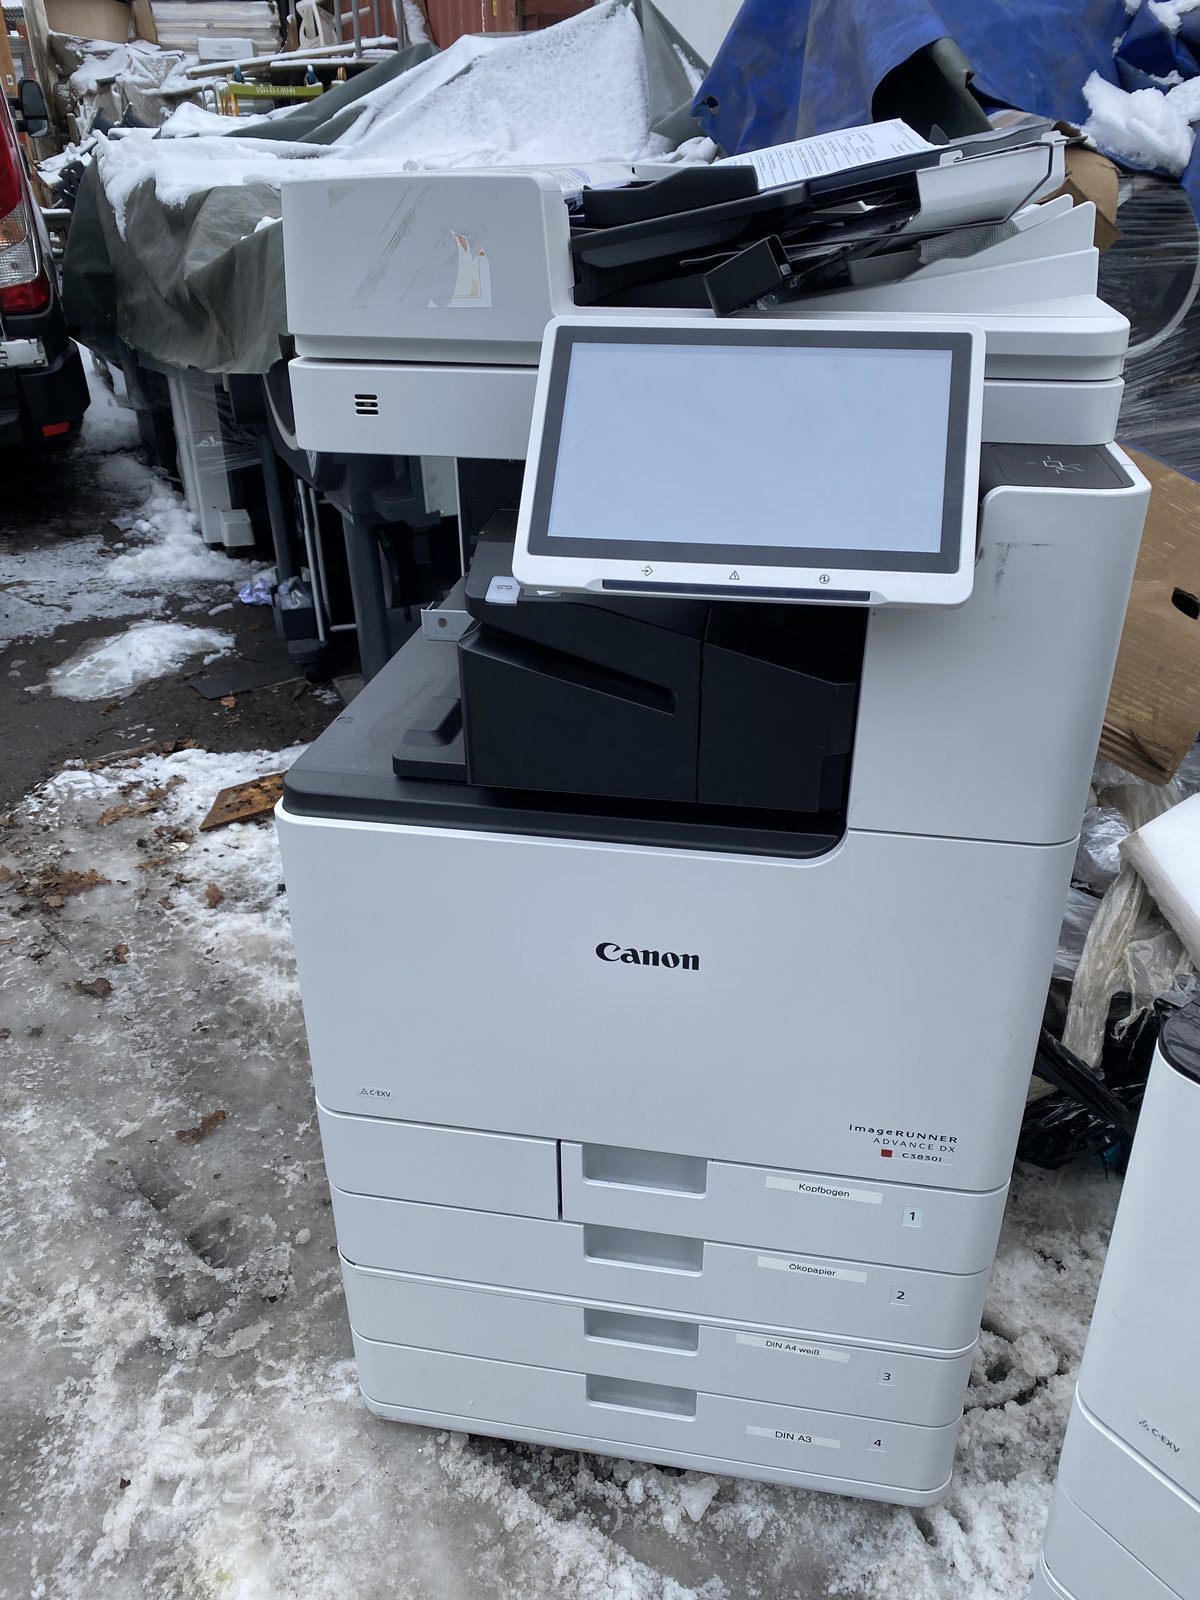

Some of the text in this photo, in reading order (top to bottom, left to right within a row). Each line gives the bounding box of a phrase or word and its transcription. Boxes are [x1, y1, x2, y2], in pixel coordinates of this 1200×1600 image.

[595, 942, 700, 971] Canon
[873, 1136, 957, 1154] ADVANCE DX
[798, 1183, 850, 1199] Kopfbogen
[908, 1211, 917, 1221] 1
[896, 1290, 905, 1301] 2
[765, 1340, 783, 1350] DIN
[784, 1342, 797, 1352] A4
[882, 1372, 892, 1382] 3
[775, 1430, 813, 1444] DIN A3
[873, 1439, 882, 1447] 4
